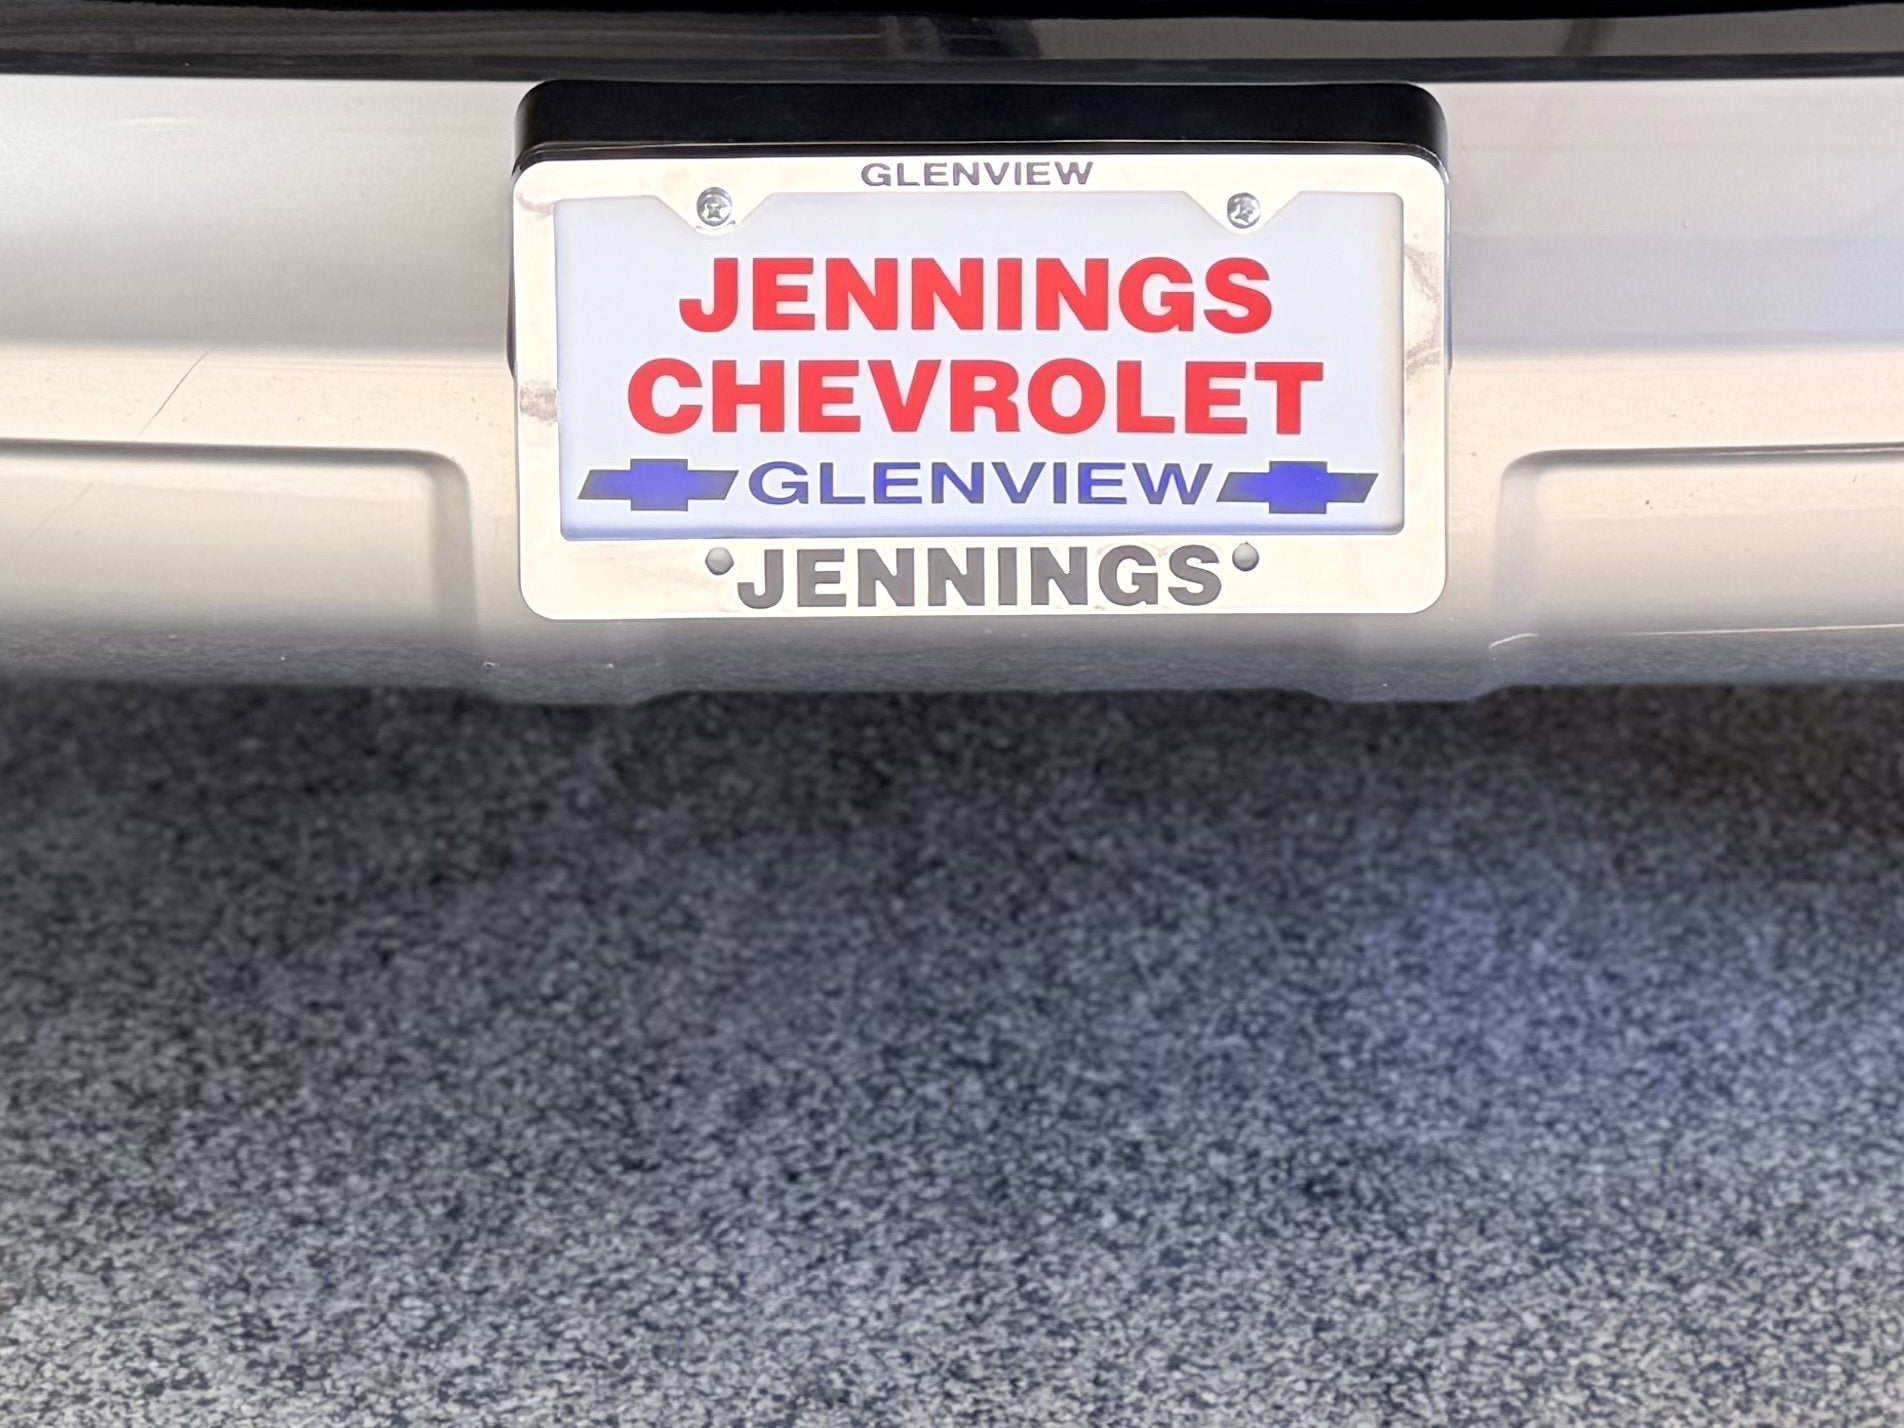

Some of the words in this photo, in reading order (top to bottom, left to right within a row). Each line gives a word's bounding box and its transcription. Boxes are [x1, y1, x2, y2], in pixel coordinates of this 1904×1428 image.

[861, 161, 1094, 187] GLENVIEW
[678, 257, 1273, 333] JENNINGS
[627, 358, 1324, 435] CHEVROLET
[747, 460, 1216, 506] GLENVIEW
[737, 545, 1223, 608] JENNINGS
